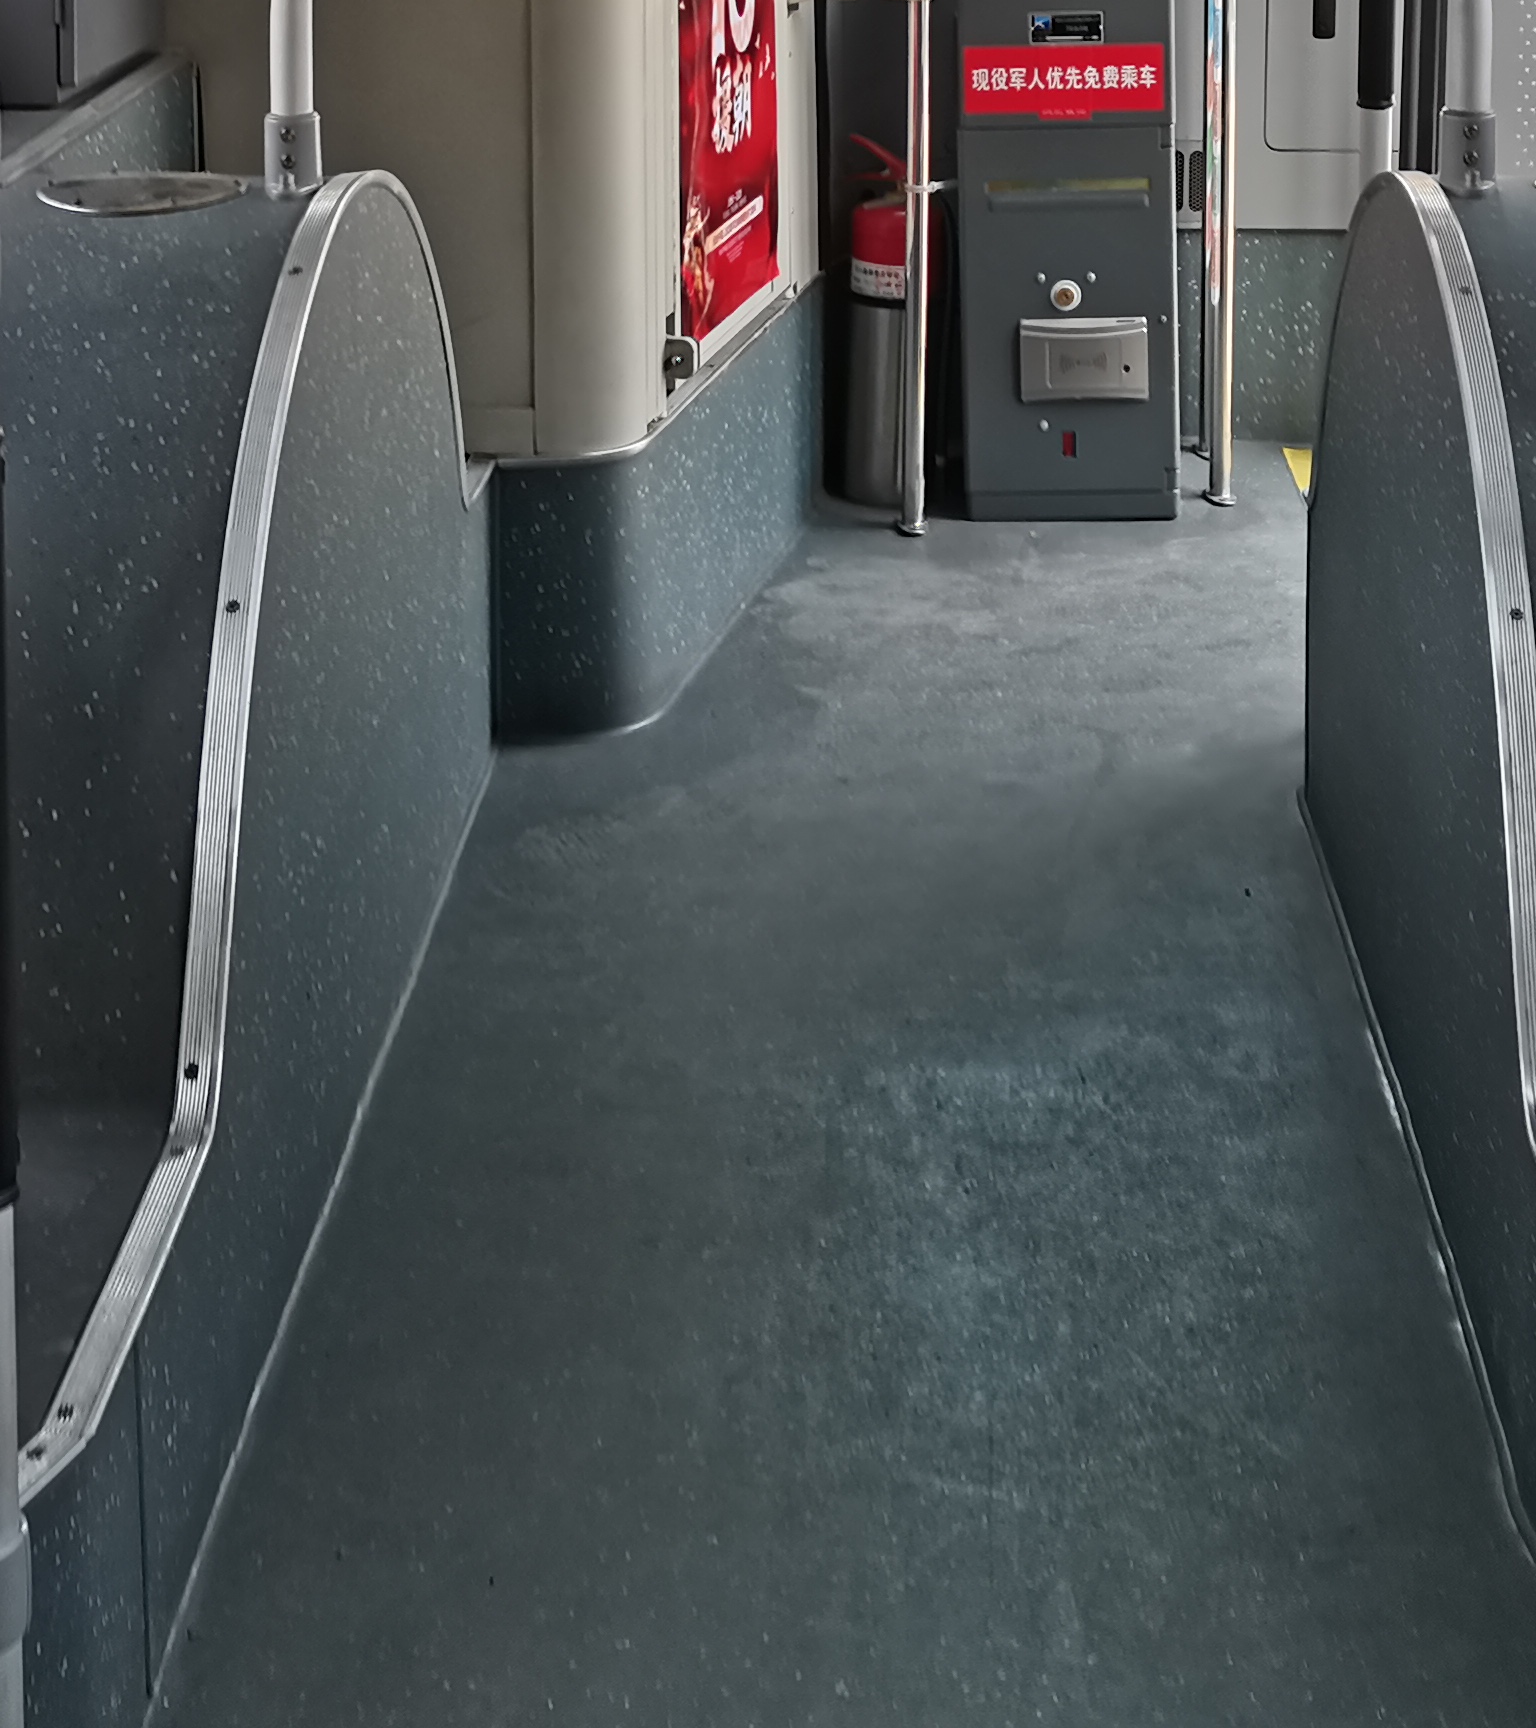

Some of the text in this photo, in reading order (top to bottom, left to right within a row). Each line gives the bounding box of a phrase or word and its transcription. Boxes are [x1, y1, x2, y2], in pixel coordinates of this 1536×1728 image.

[971, 64, 1157, 91] 现役军人优先免费乘车
